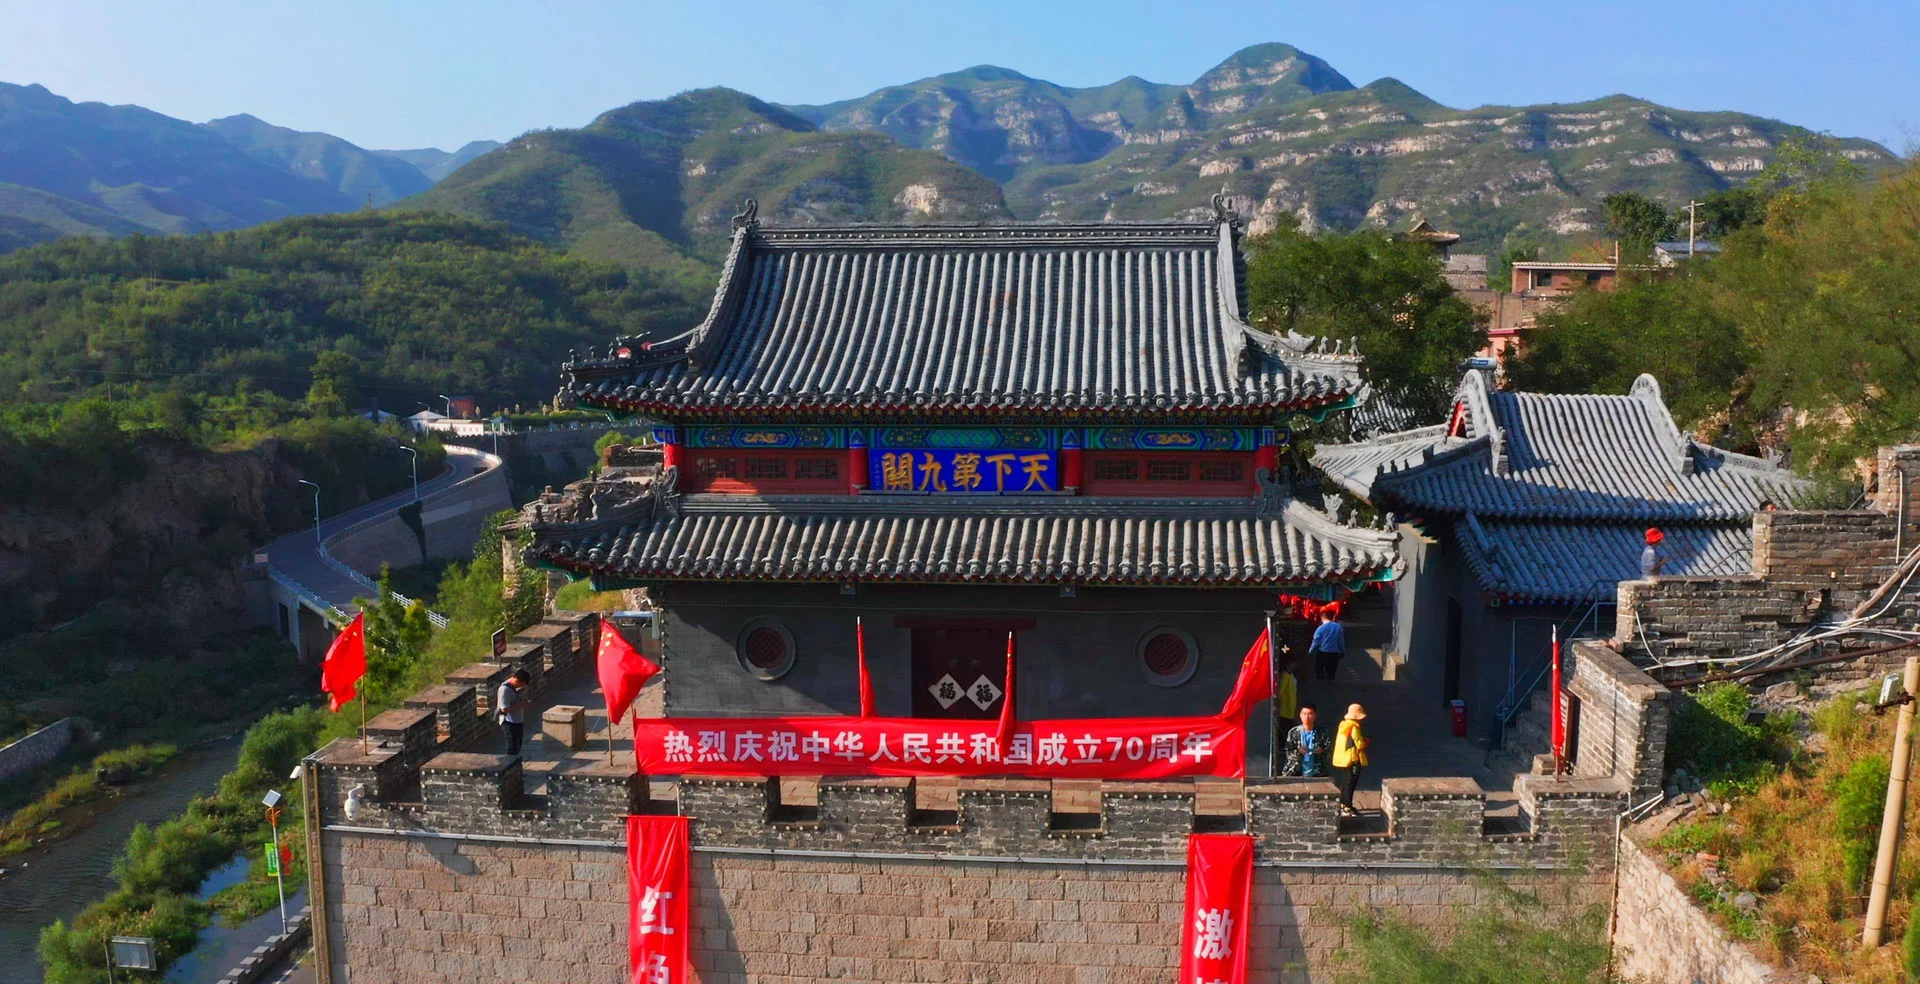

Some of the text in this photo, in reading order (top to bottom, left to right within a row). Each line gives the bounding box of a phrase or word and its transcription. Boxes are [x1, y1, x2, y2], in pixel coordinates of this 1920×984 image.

[939, 682, 956, 700] 福
[976, 684, 993, 703] 福
[663, 730, 1213, 766] 热烈庆祝中华人民共和国成立70周年
[1193, 907, 1234, 984] 激
